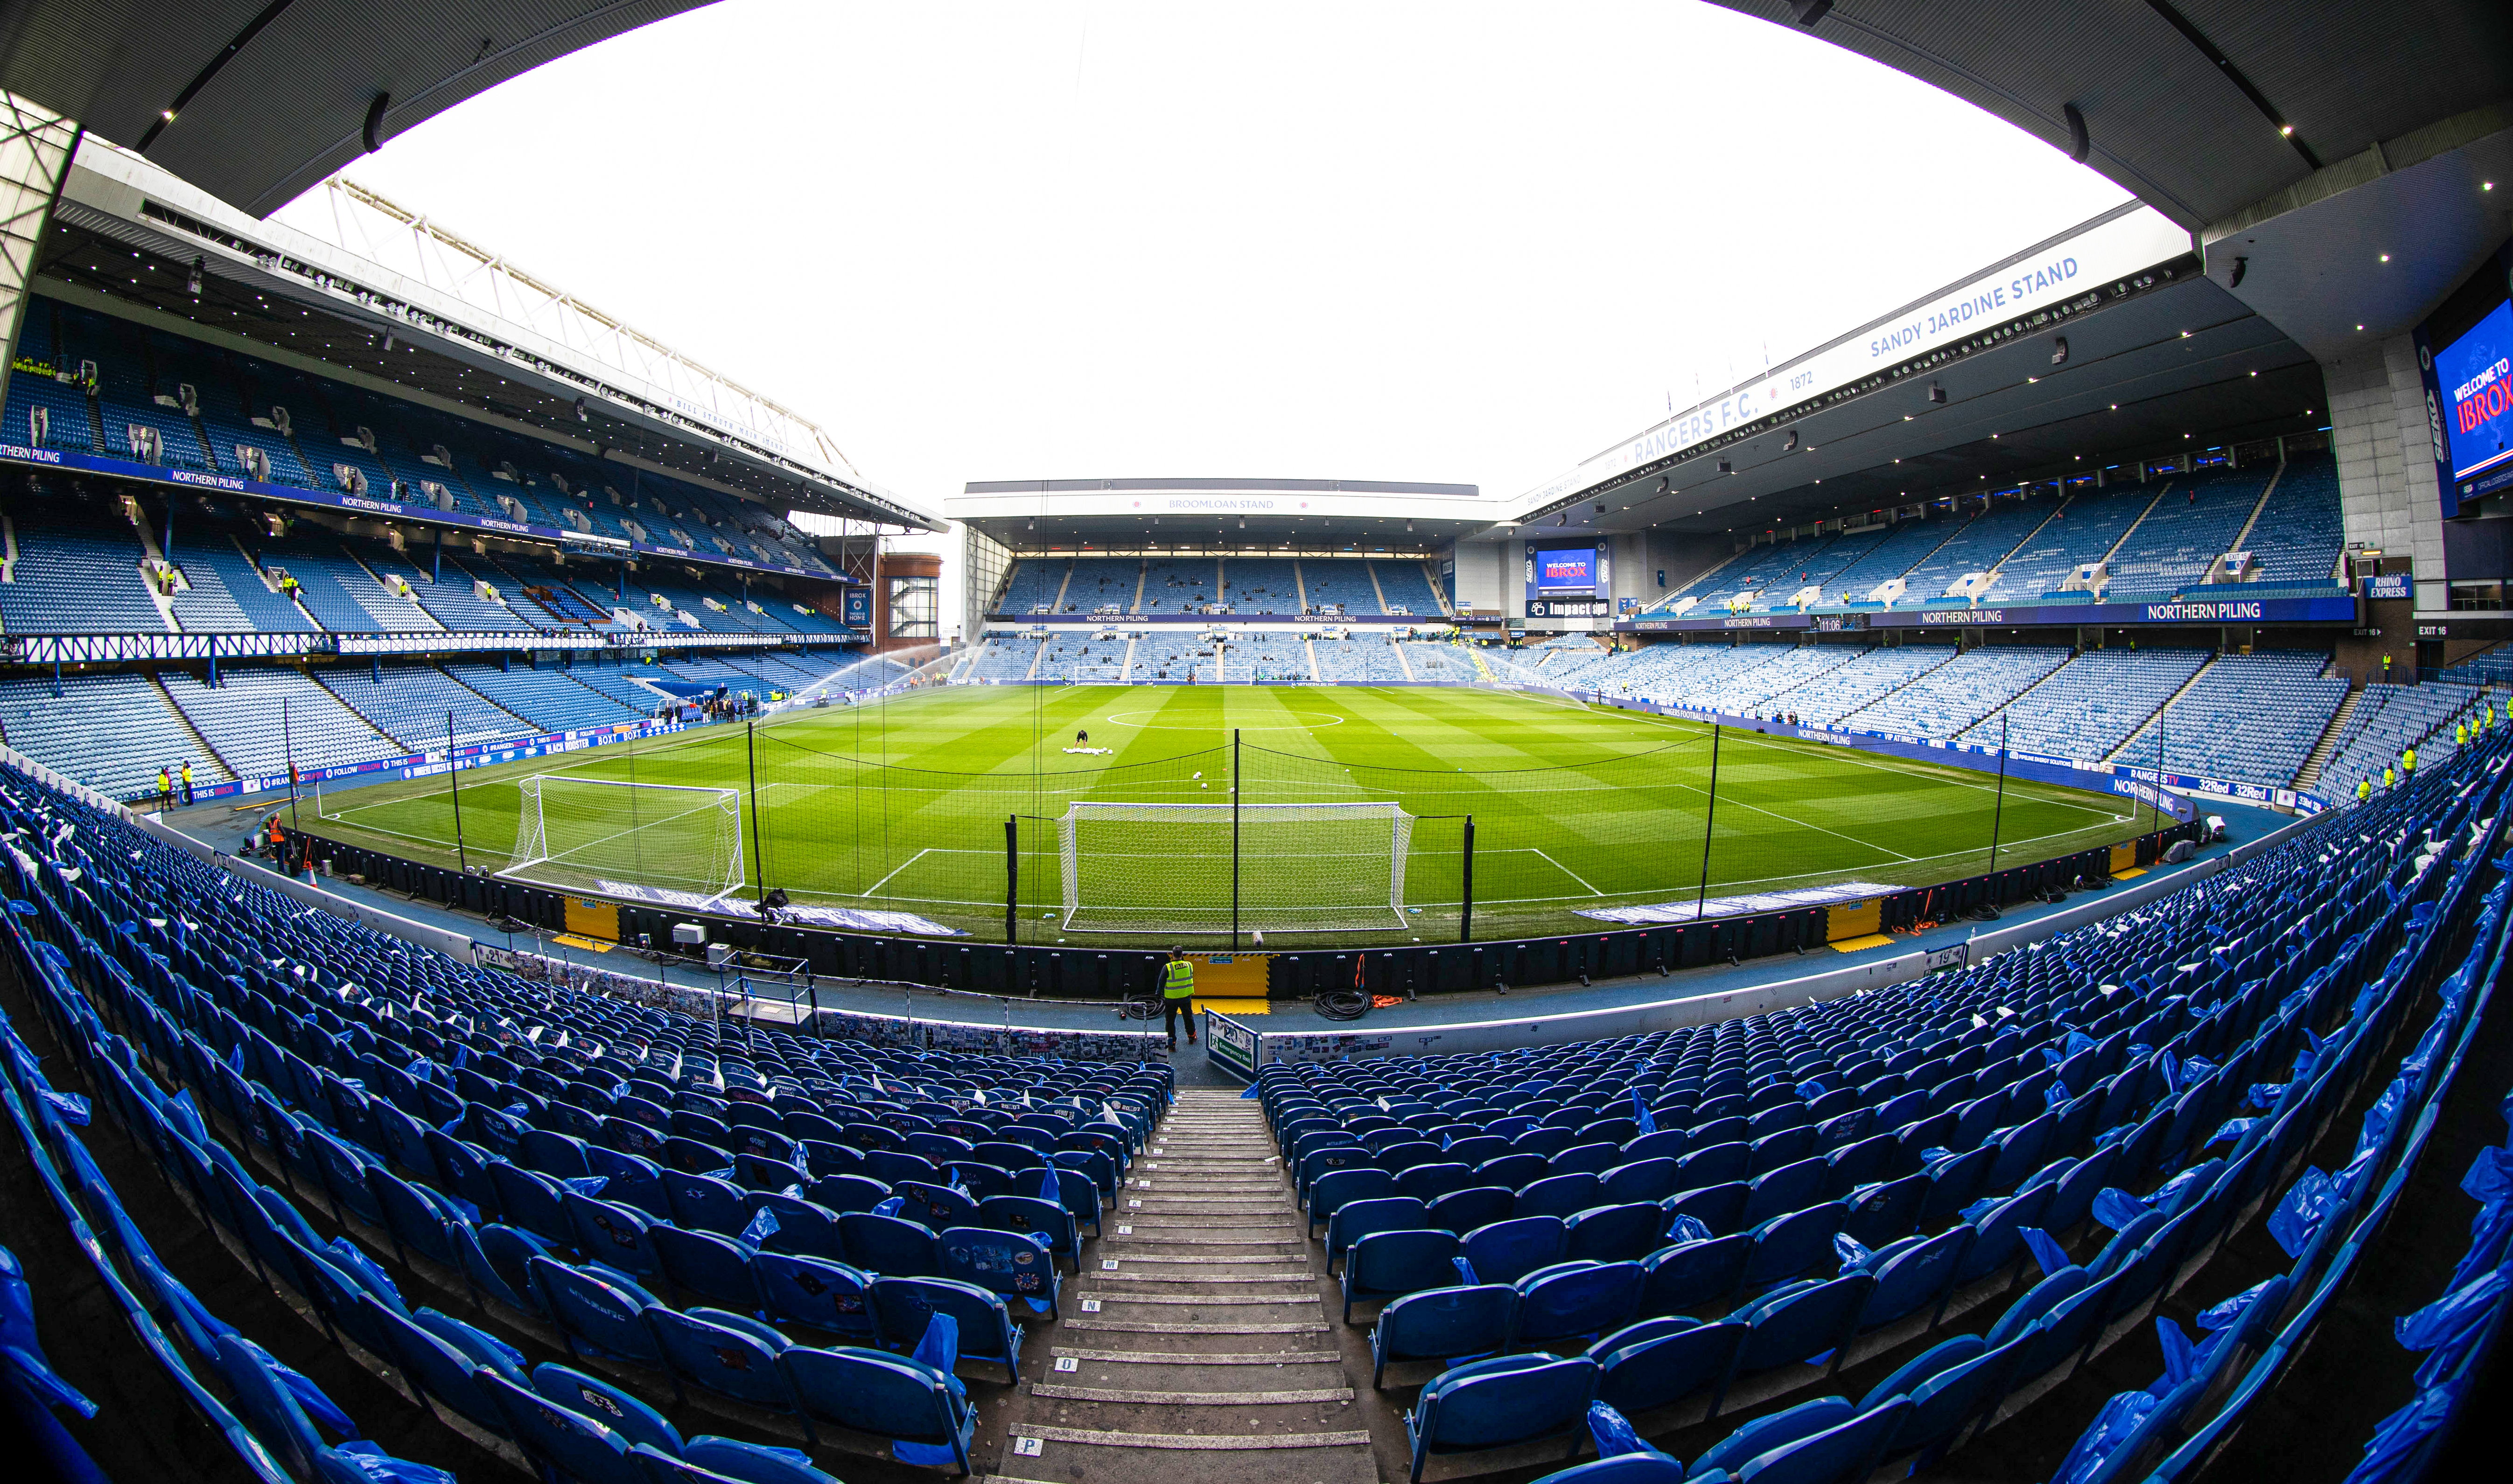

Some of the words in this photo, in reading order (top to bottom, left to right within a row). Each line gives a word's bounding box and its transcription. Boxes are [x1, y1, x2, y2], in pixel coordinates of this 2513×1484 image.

[1871, 322, 1921, 357] SANDY
[1928, 287, 2006, 334] JARDINE
[2011, 257, 2078, 299] STAND
[1790, 371, 1813, 390] 1872
[2454, 366, 2496, 402] WELCOME
[2495, 357, 2509, 376] TO
[2457, 374, 2513, 434] IBROX
[677, 400, 697, 414] BILL
[703, 411, 733, 430] STRUTH
[739, 427, 757, 439] MAIN
[2427, 389, 2445, 463] SEKO
[1635, 410, 1713, 463] RANGERS
[1721, 393, 1758, 426] F.C.
[32, 450, 60, 463] PILING
[172, 471, 217, 487] NORTHERN
[218, 477, 244, 490] PILING
[342, 497, 380, 511] NORTHERN
[380, 502, 402, 513] PILING
[1169, 500, 1237, 508] BROOMLOAN
[1239, 500, 1274, 509] STAND
[481, 518, 512, 530] NORTHERN
[512, 523, 529, 532] PILING
[656, 546, 676, 555] NORTHERN
[1546, 567, 1587, 578] IBROX
[2375, 577, 2401, 587] RHINO
[2371, 587, 2406, 598] EXPRESS
[1550, 602, 1590, 616] Impact
[1592, 602, 1607, 616] signs
[2148, 604, 2216, 620] NORTHERN
[2219, 602, 2261, 619] PILING
[1724, 619, 1752, 627] NORTHERN
[1753, 618, 1770, 626] PILING
[1922, 612, 1971, 623] NORTHERN
[1972, 610, 2002, 623] PILING
[1822, 620, 1840, 631] 11:06
[2419, 627, 2436, 635] EXIT
[2438, 627, 2446, 635] 16
[1661, 707, 1680, 717] RANGERS
[1680, 711, 1704, 721] FOOTBALL
[1704, 714, 1717, 723] CLUB
[598, 734, 617, 745] BOXT
[623, 730, 641, 741] BOXT
[1798, 729, 1830, 742] NORTHERN
[1830, 734, 1850, 745] PILING
[1884, 733, 1893, 742] VIP
[1901, 735, 1918, 745] IBROX
[490, 742, 514, 751] #RANGERS
[546, 744, 564, 754] BLACK
[565, 739, 589, 751] ROOSTER
[1983, 746, 1998, 755] UNIBET
[2034, 756, 2050, 765] ENERGY
[2050, 758, 2072, 767] SOLUTIONS
[334, 766, 358, 776] FOLLOW
[18, 759, 24, 768] H
[32, 766, 37, 775] G
[46, 773, 50, 782] F
[58, 779, 63, 788] E
[71, 786, 77, 795] D
[84, 792, 90, 801] C
[97, 798, 102, 807] B
[111, 804, 116, 813] A
[272, 775, 305, 787] #RANRS
[2199, 779, 2229, 794] 32Red
[193, 788, 208, 799] THIS
[208, 788, 215, 797] IS
[2235, 785, 2266, 799] 32Red
[2298, 795, 2313, 808] 32Red
[489, 949, 500, 963] 21
[1939, 951, 1949, 965] 19
[1219, 1042, 1242, 1059] Emergency
[1242, 1054, 1251, 1063] Exit
[1087, 1301, 1096, 1310] N
[1062, 1359, 1071, 1370] O
[1024, 1439, 1036, 1453] P
